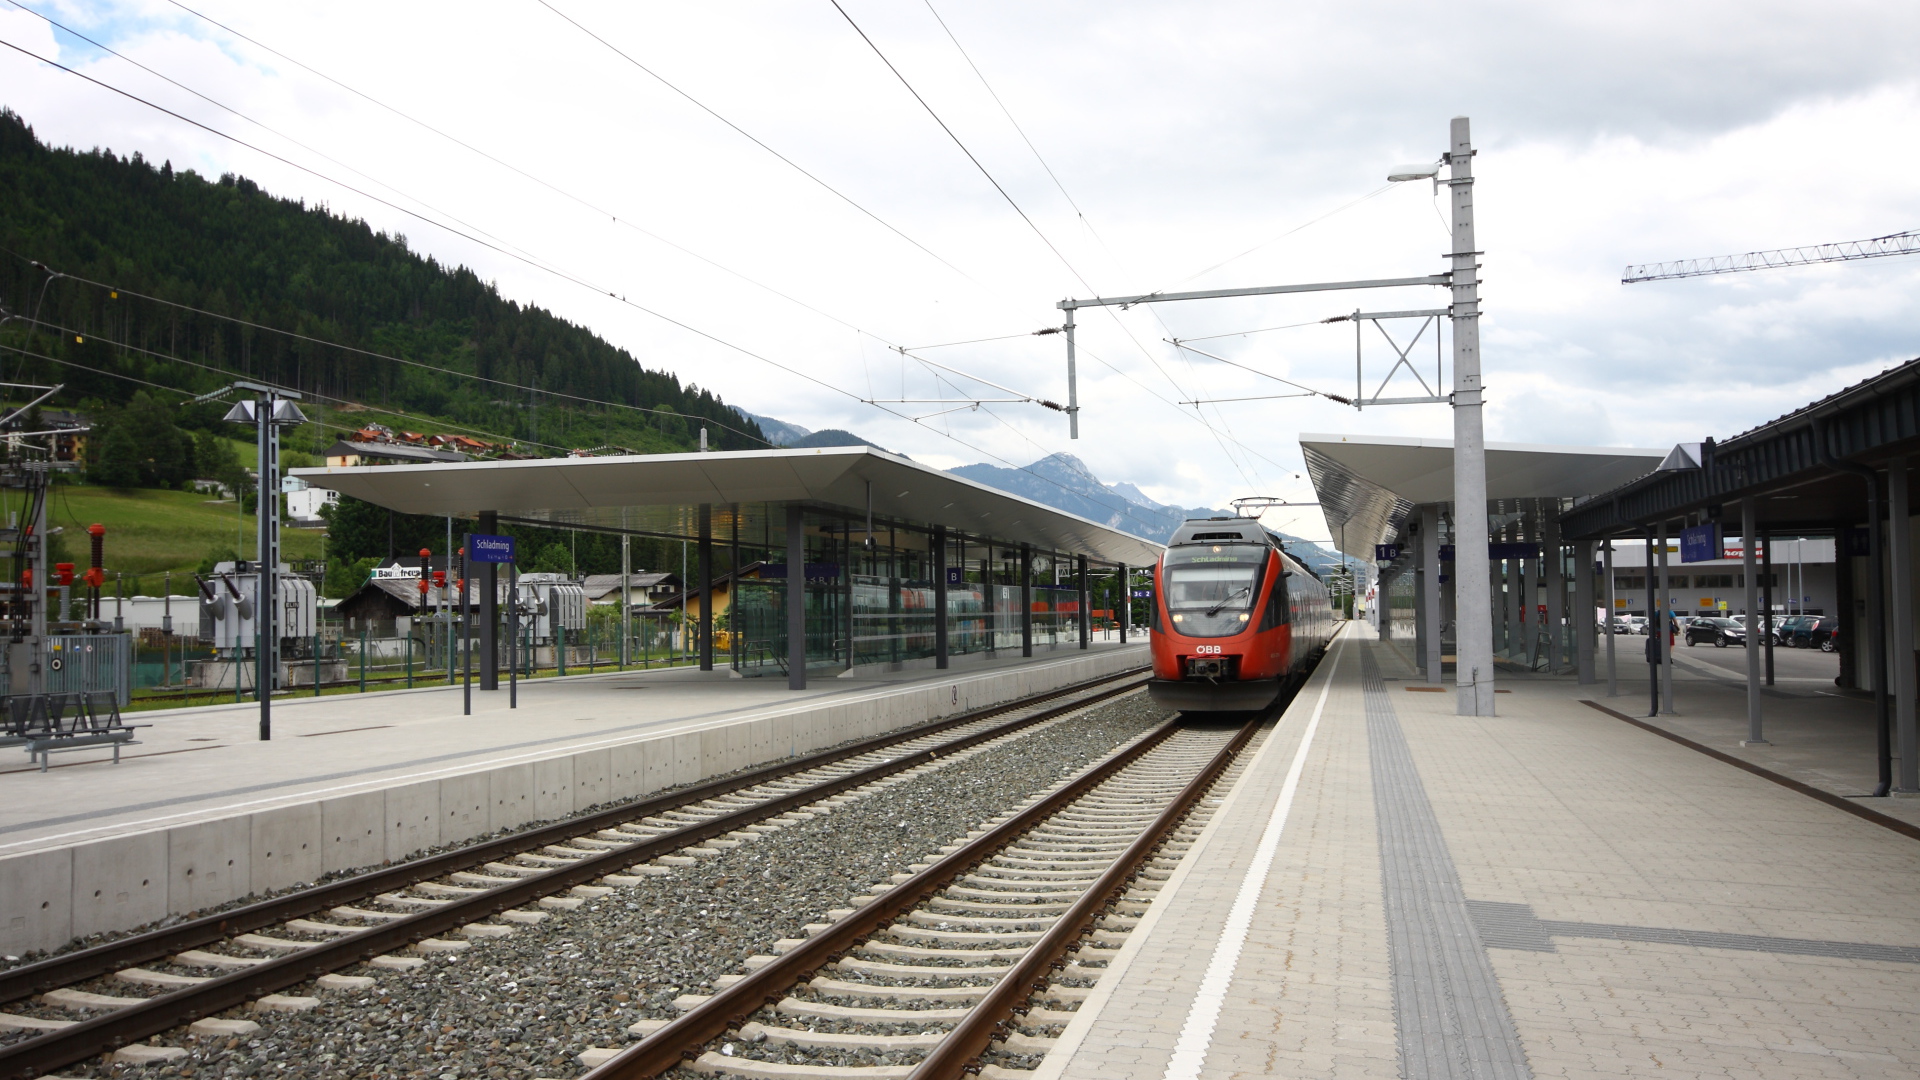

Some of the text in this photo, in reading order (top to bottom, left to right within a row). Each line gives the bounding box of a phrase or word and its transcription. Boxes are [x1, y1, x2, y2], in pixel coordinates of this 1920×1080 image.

[476, 539, 510, 552] Schladming
[1380, 547, 1396, 557] 1 B
[951, 572, 957, 581] B
[1196, 645, 1221, 654] ÖBB
